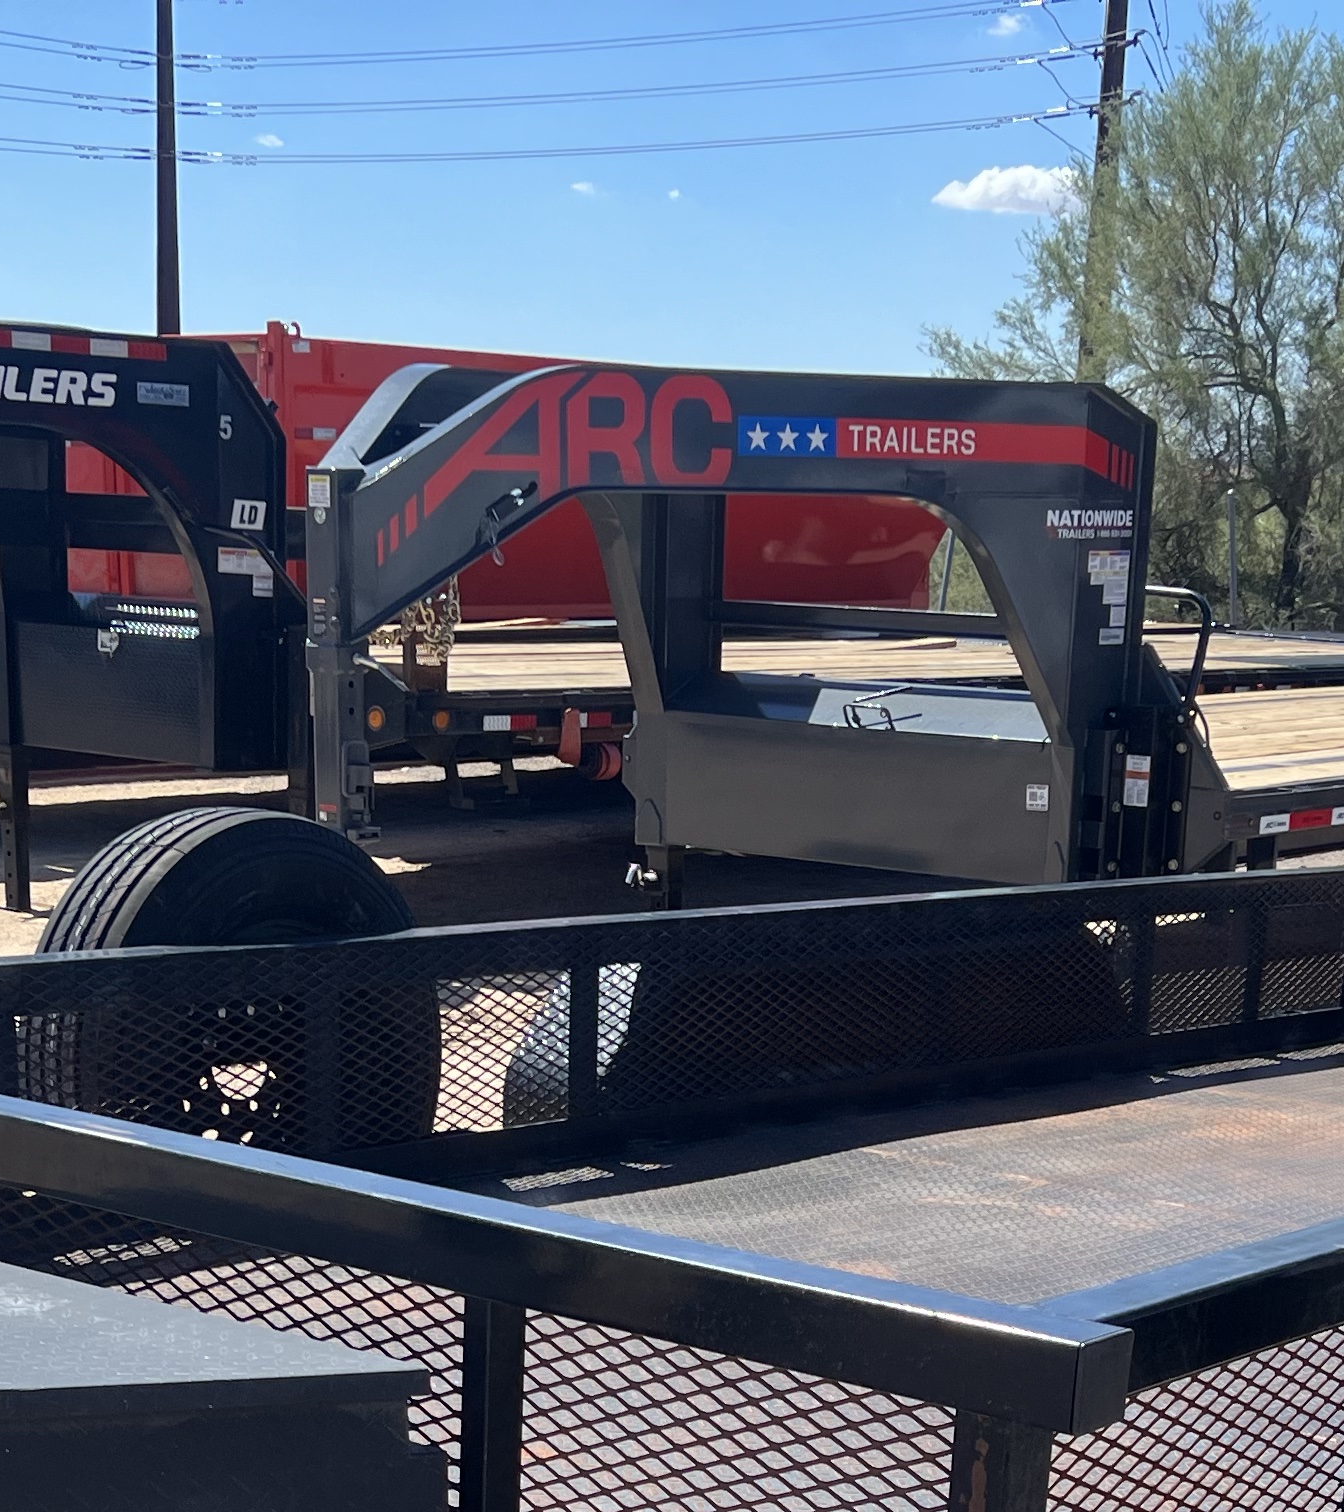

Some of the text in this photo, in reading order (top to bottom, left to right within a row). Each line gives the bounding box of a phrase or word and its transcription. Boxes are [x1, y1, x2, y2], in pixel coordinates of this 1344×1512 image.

[219, 414, 233, 440] 5
[423, 371, 977, 518] ARC TRAILERS
[239, 504, 259, 525] LD
[1046, 509, 1133, 527] NATIONWIDE
[1057, 528, 1095, 539] TRAILERS
